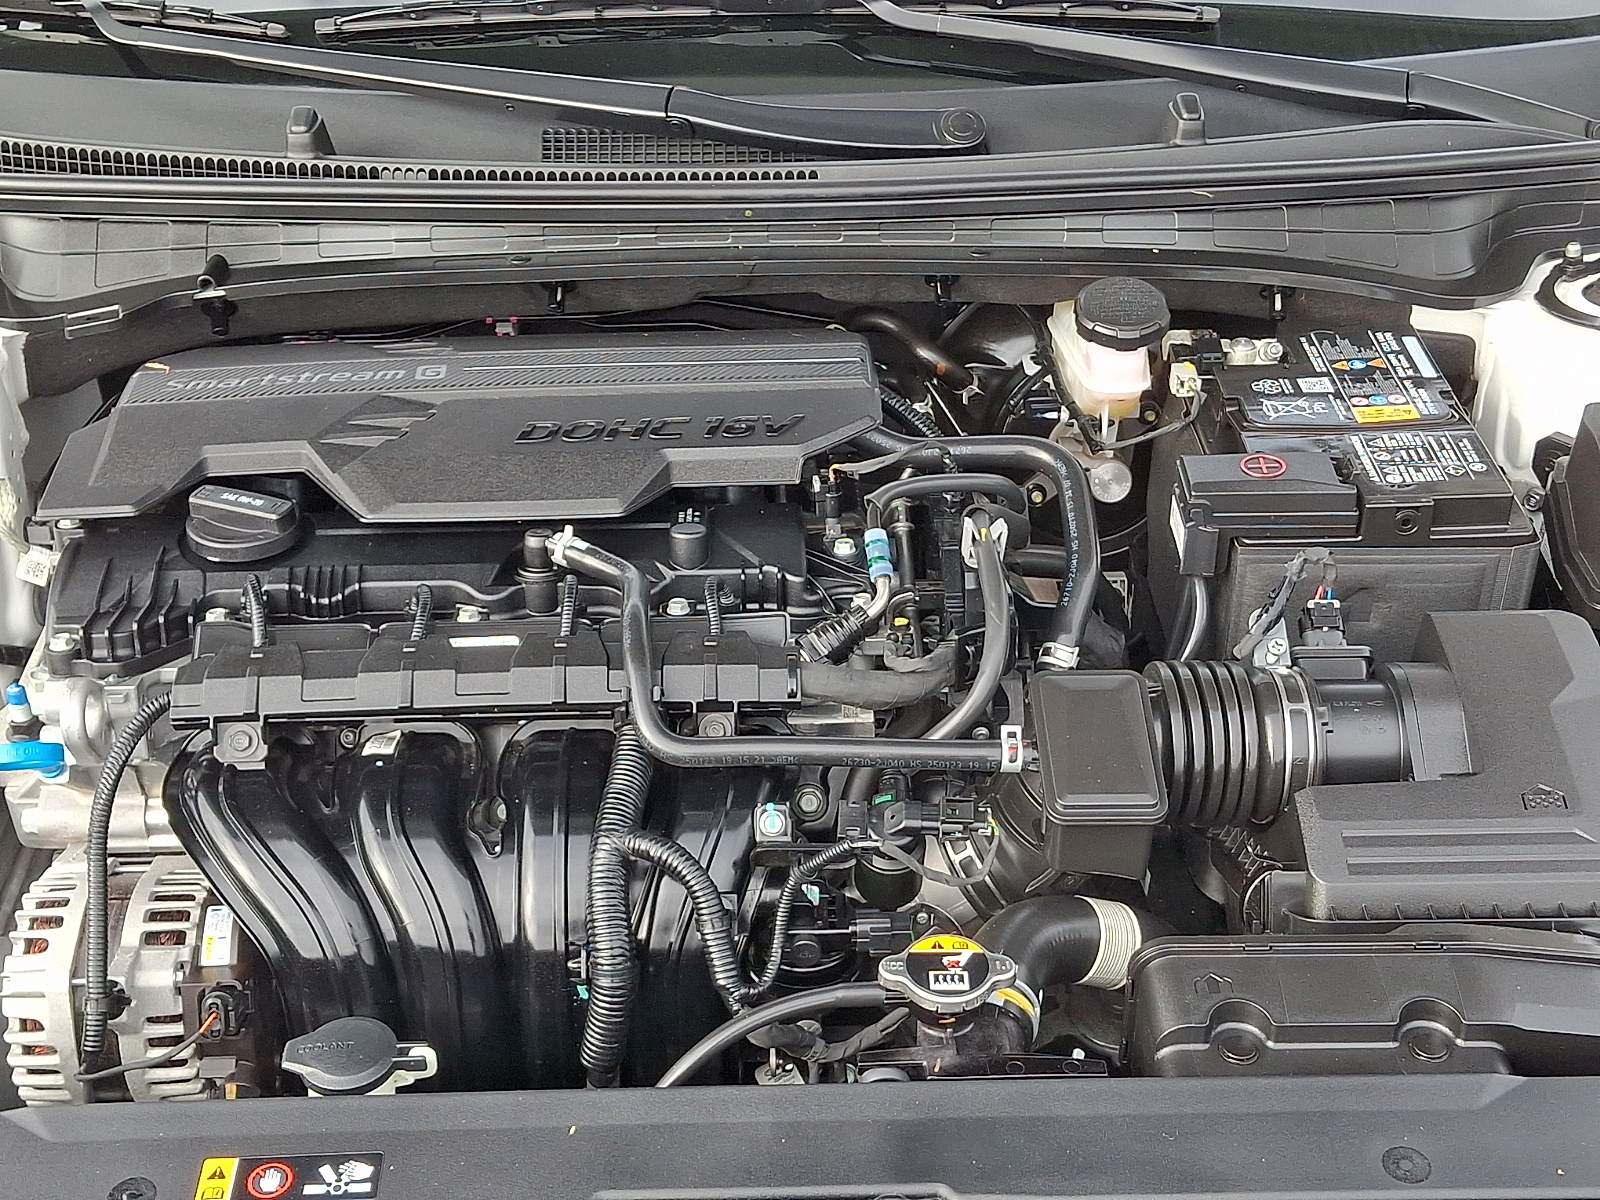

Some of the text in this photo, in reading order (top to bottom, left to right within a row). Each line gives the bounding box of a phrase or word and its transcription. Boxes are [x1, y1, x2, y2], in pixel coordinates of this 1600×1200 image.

[514, 413, 805, 444] DOHC 16V
[297, 1041, 355, 1053] COOLANT
